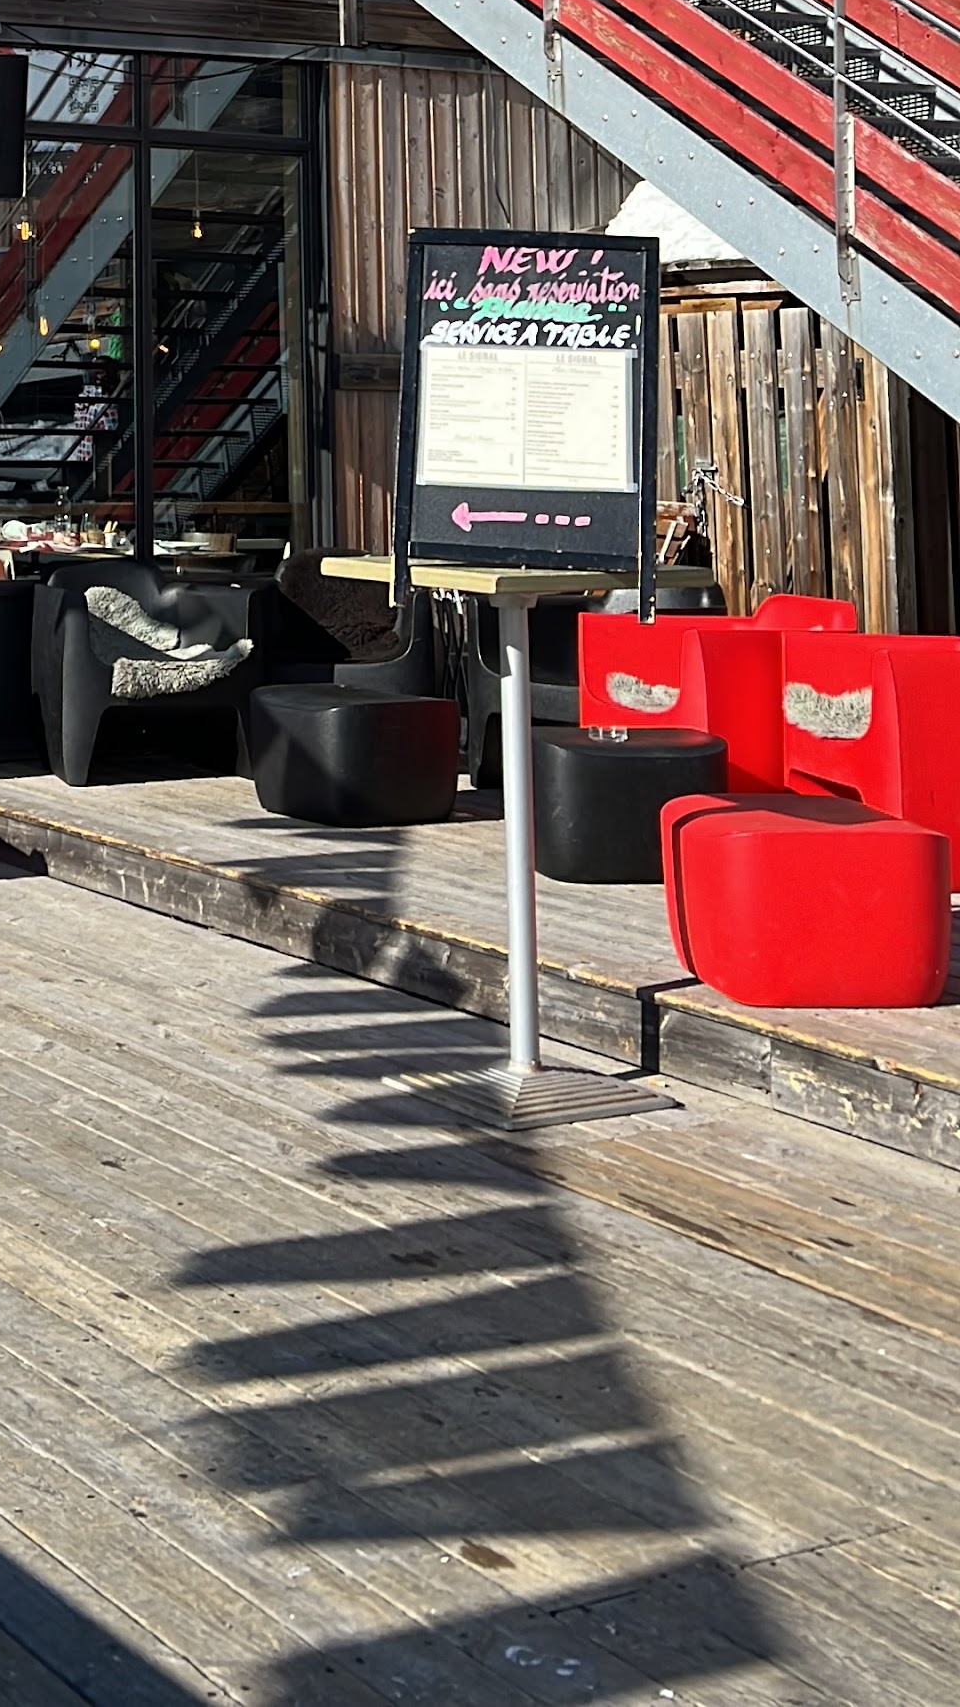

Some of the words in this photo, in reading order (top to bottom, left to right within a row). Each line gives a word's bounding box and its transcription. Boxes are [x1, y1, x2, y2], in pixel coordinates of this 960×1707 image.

[477, 245, 579, 276] NEW
[423, 269, 457, 301] ici
[465, 276, 522, 304] sans
